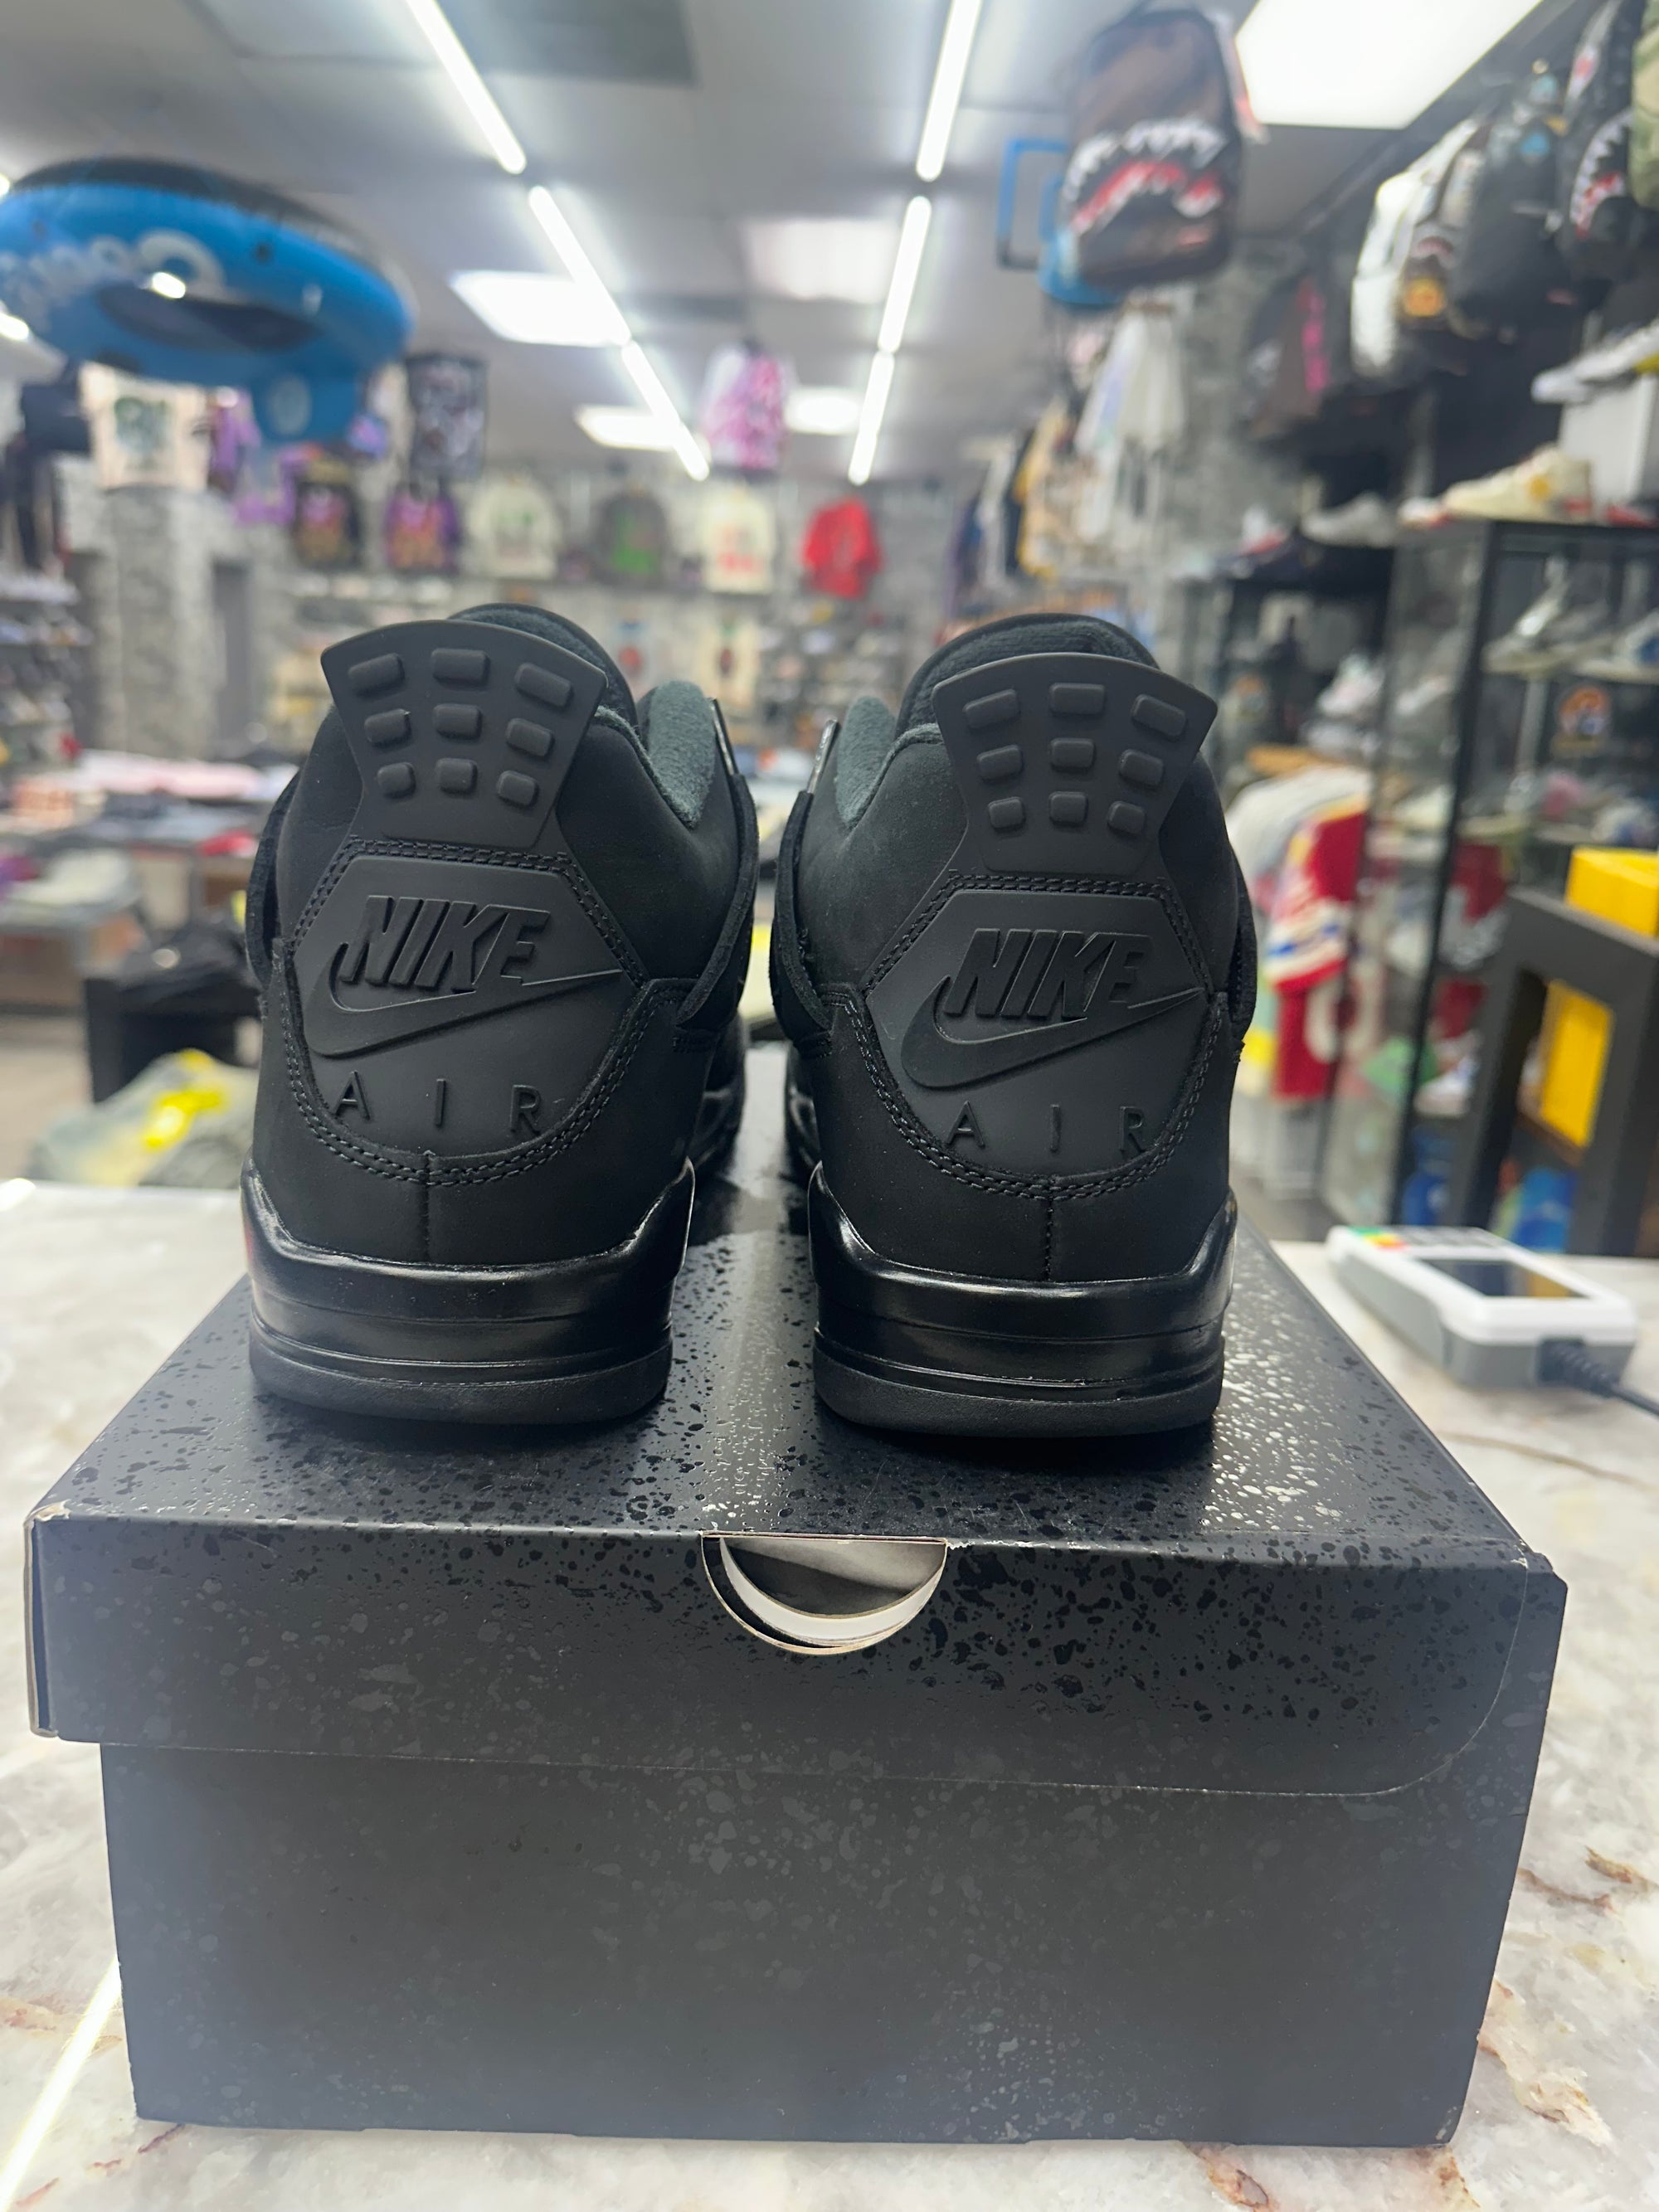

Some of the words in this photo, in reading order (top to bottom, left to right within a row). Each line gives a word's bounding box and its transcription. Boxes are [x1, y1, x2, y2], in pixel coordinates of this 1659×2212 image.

[338, 895, 551, 993] NIKE
[942, 928, 1154, 1020] NIKE
[333, 1071, 541, 1135] AIR
[946, 1101, 1146, 1154] AIR
